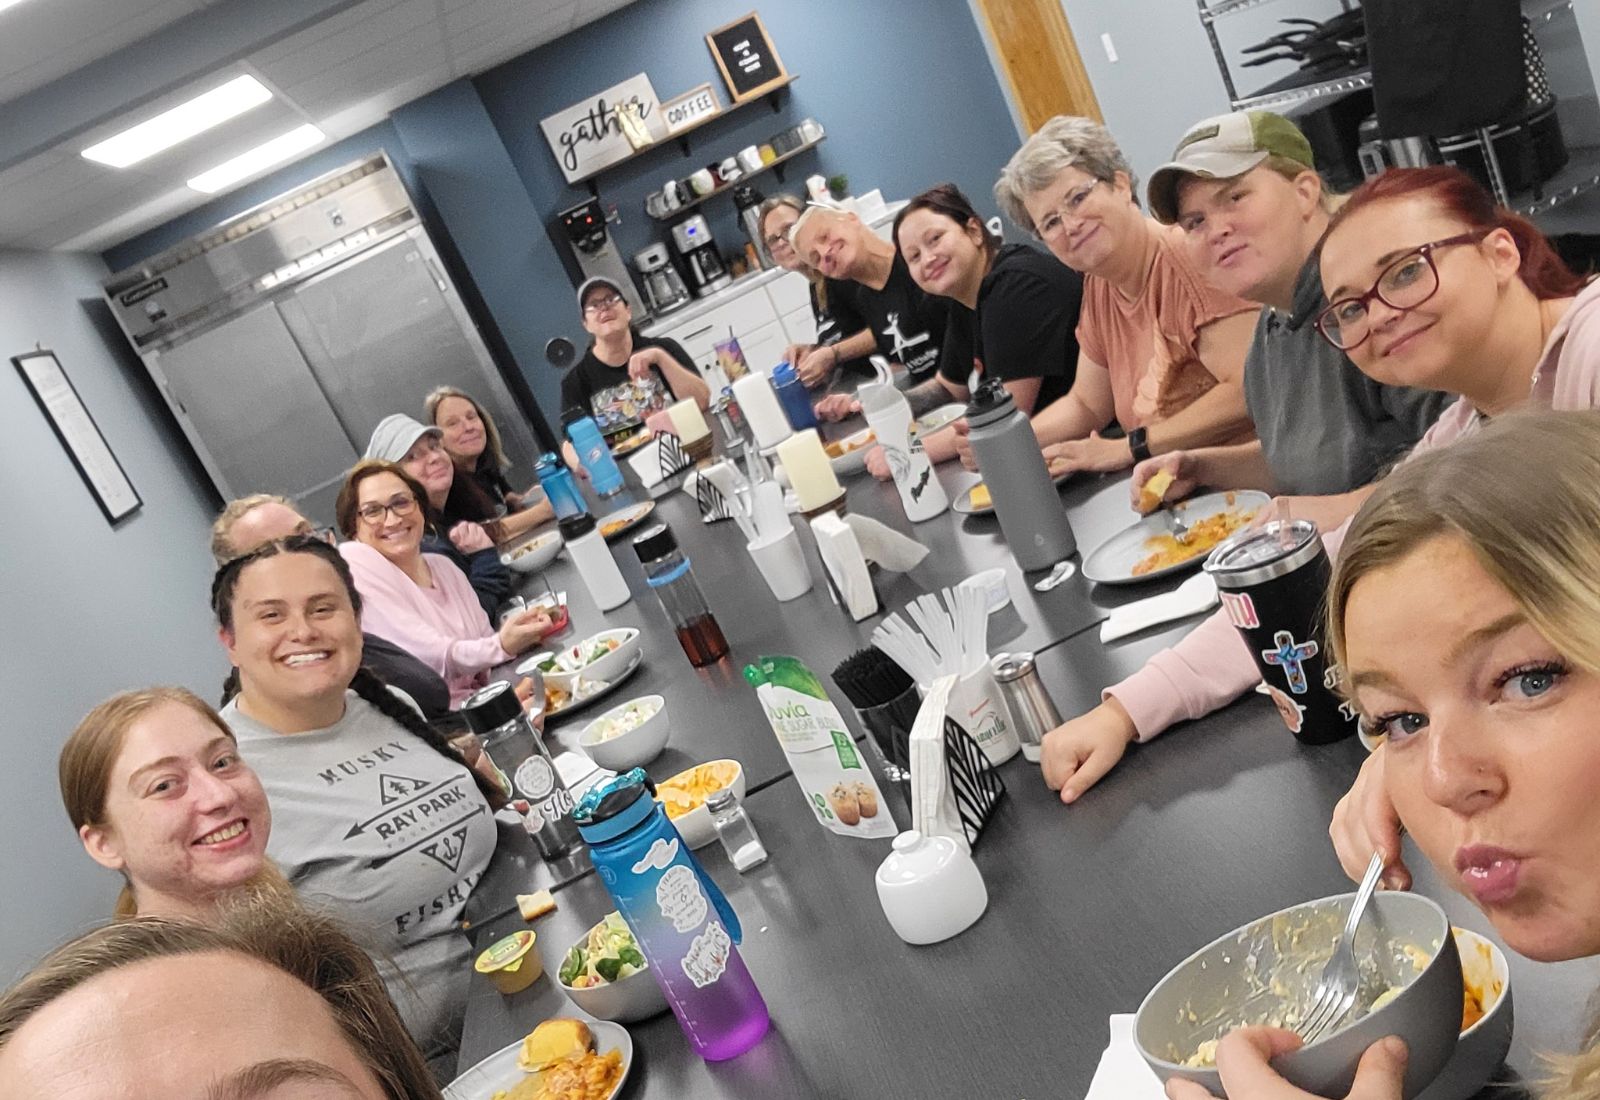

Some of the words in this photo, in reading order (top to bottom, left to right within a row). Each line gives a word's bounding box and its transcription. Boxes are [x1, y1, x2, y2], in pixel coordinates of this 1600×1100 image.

[560, 96, 652, 171] gathr
[668, 94, 713, 124] COFFEE
[317, 741, 409, 786] MUSKY
[375, 809, 418, 840] RAY
[417, 786, 466, 817] PARK
